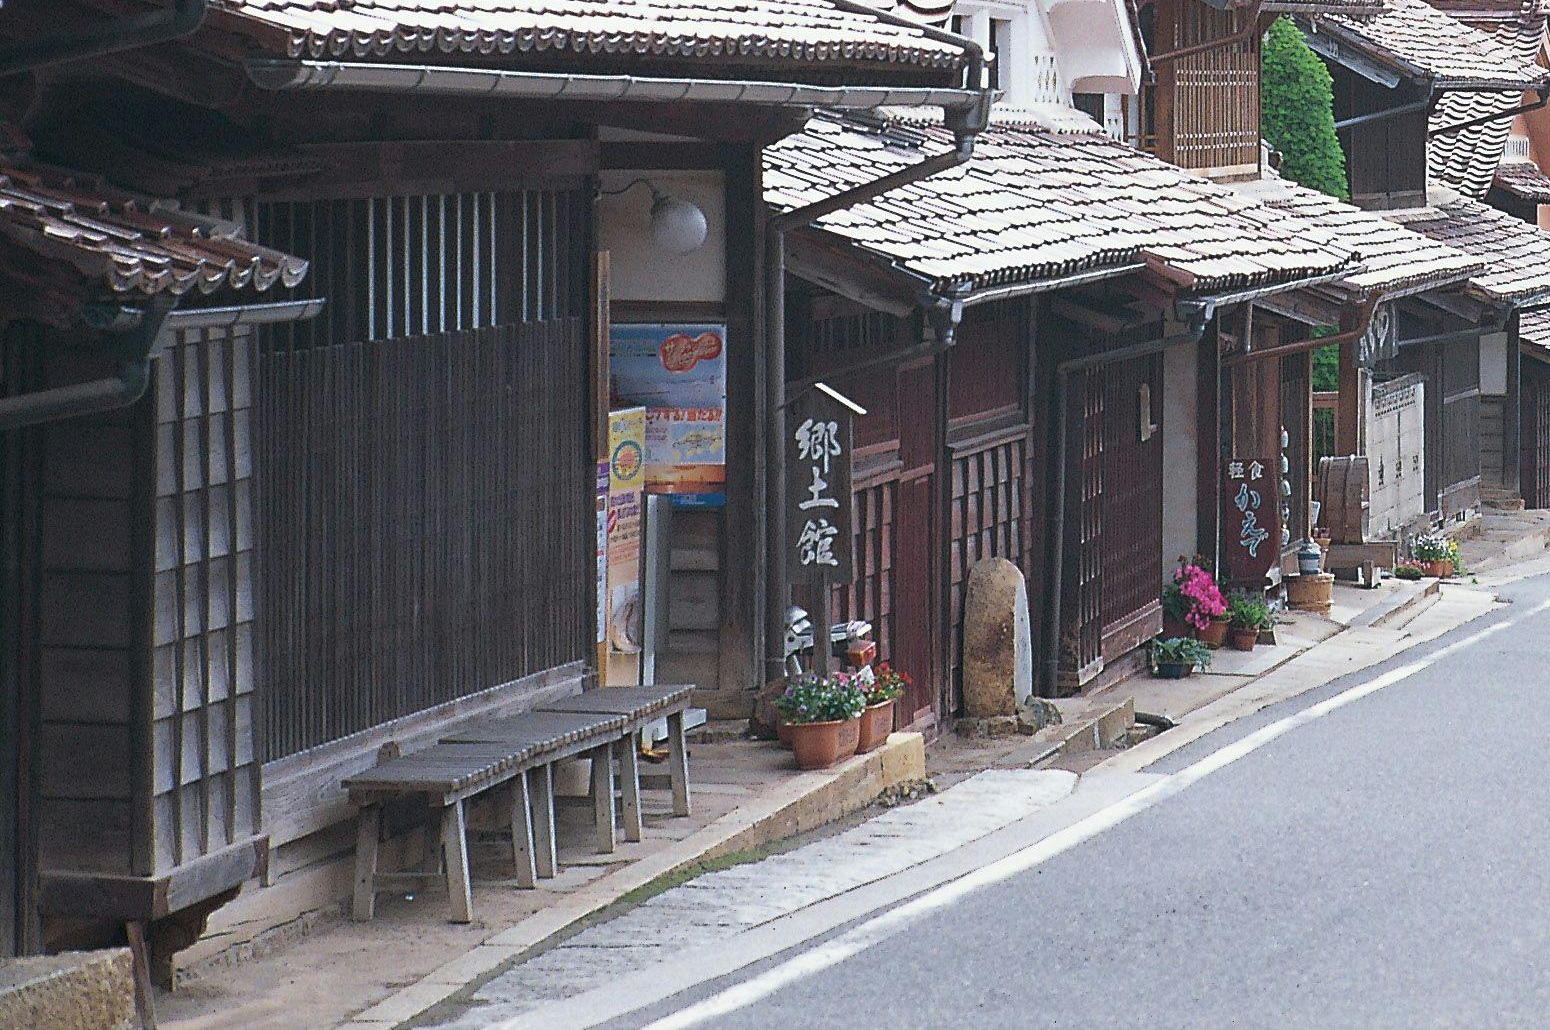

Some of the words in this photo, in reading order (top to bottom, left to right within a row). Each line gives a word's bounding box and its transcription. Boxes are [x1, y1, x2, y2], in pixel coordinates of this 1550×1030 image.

[795, 418, 842, 566] 郷土館
[1228, 460, 1265, 481] 軽食
[1234, 483, 1269, 558] かえで
